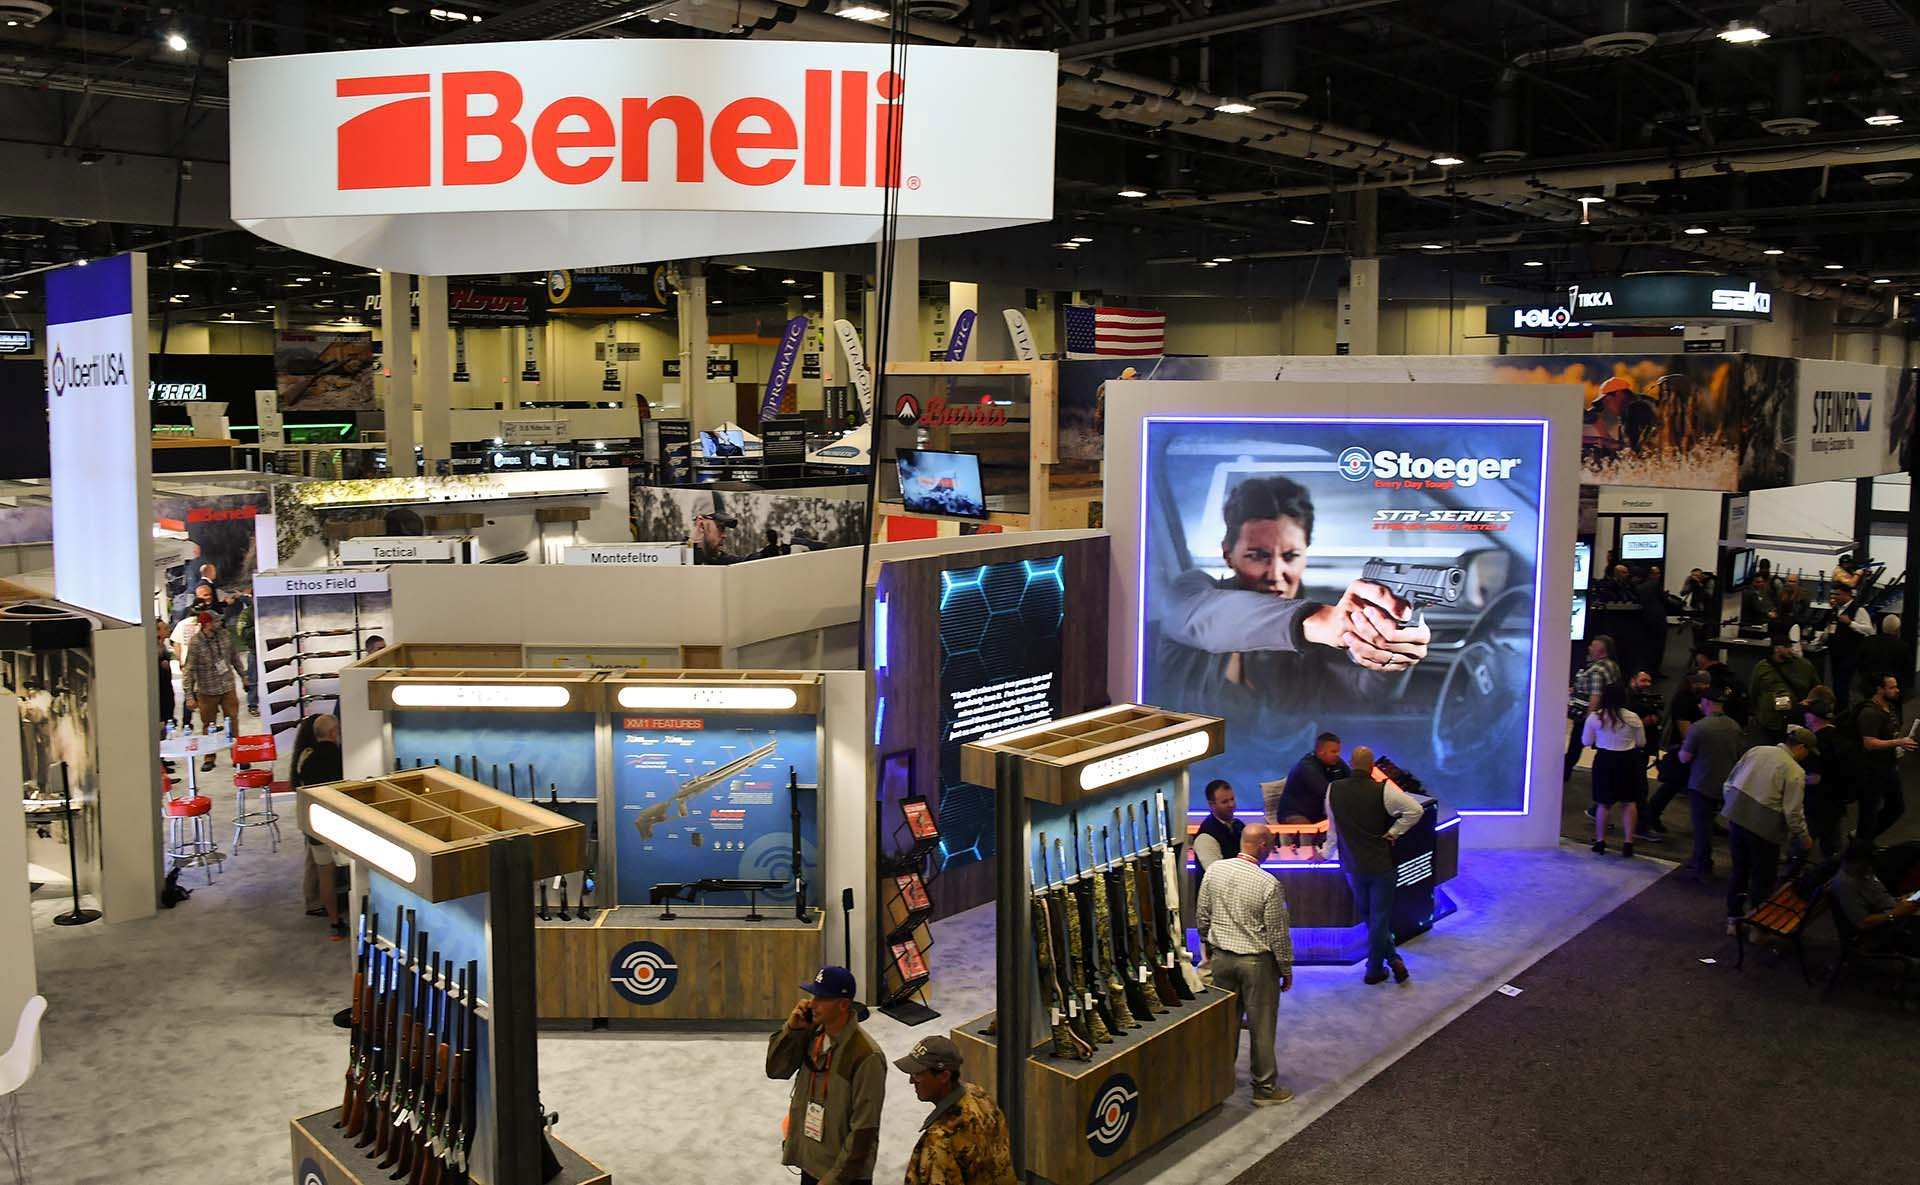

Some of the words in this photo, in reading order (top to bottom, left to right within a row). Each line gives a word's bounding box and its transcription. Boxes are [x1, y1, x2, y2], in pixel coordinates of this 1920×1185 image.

[441, 69, 905, 188] Benelli
[1578, 291, 1613, 307] TIKKA
[1514, 307, 1592, 329] HOLO
[103, 352, 128, 386] USA
[768, 324, 801, 407] PROMATIC
[919, 396, 1008, 427] Burris
[1812, 391, 1857, 434] STEINER
[1373, 450, 1516, 487] Stoeger
[1374, 480, 1401, 490] Every
[1404, 480, 1423, 490] Day
[1372, 510, 1515, 523] STR-SERIES
[374, 546, 417, 559] Tactical
[592, 552, 659, 565] Montefeltro
[286, 578, 322, 591] Ethos
[326, 577, 357, 591] Field
[652, 719, 703, 730] FEATURES
